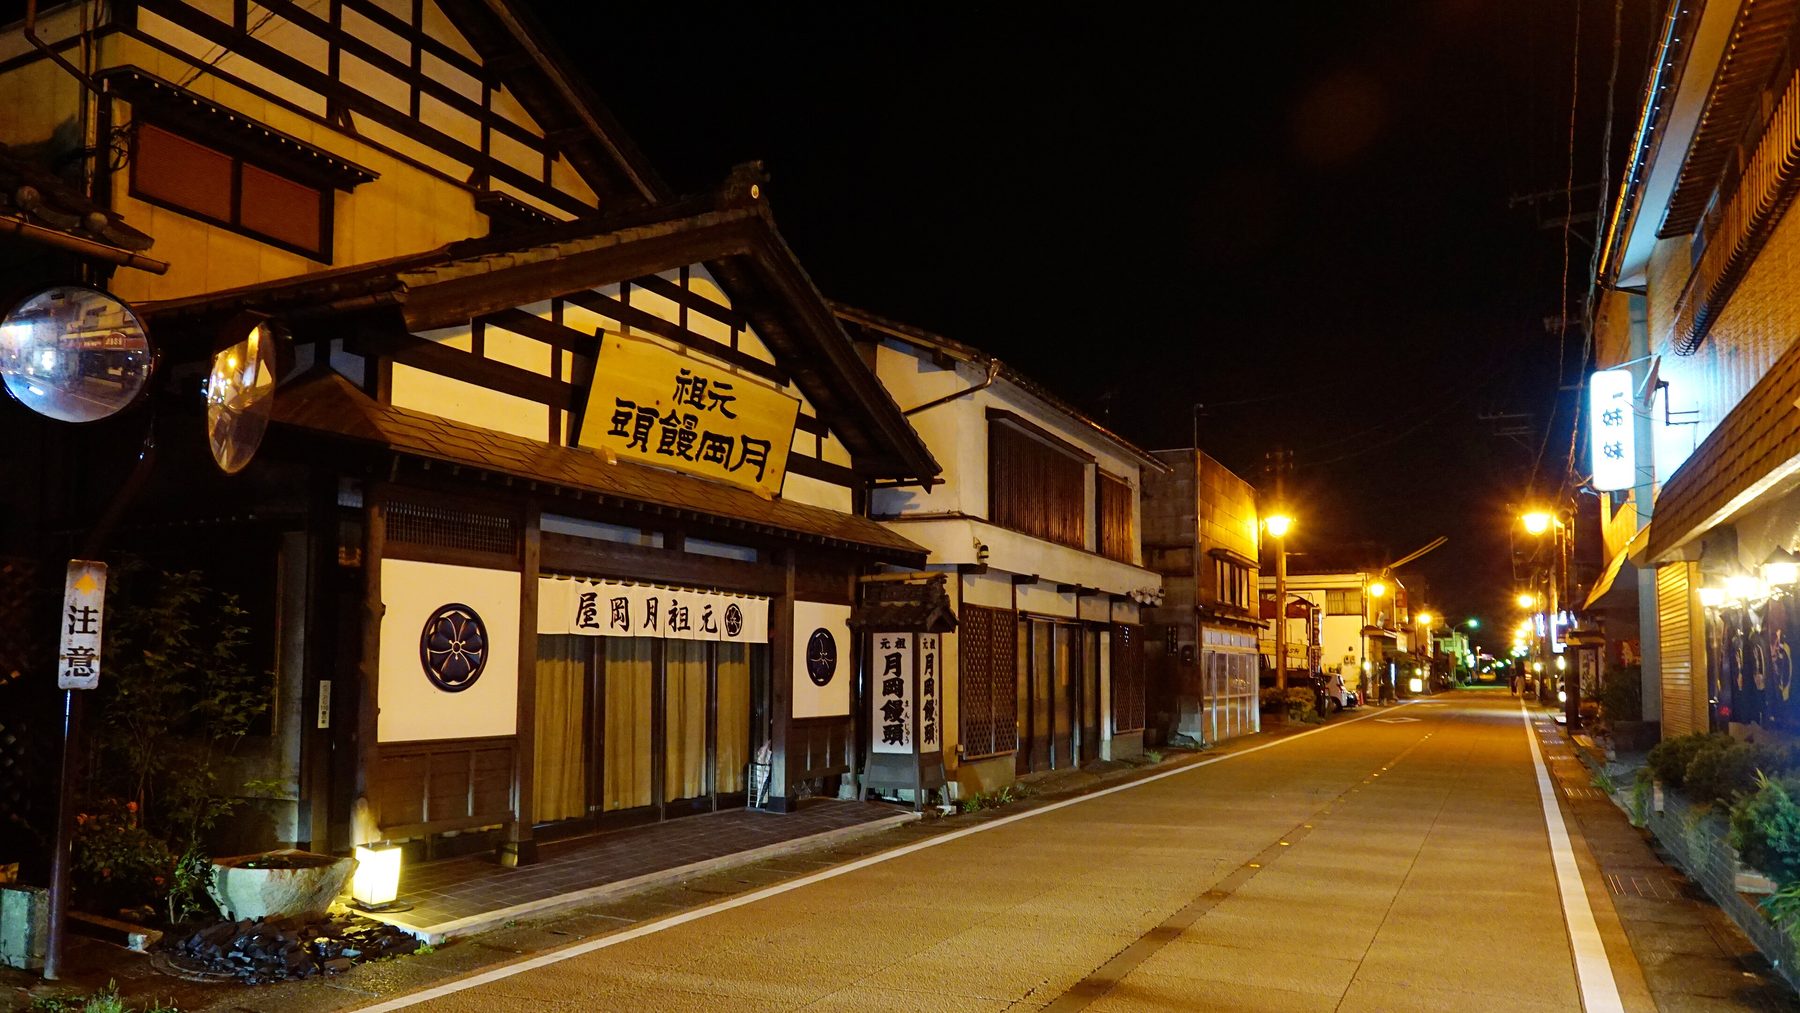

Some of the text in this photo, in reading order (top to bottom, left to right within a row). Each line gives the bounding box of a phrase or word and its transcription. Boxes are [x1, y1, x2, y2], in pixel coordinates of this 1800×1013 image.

[672, 368, 737, 419] 元祖
[65, 605, 99, 677] 注意
[880, 638, 906, 649] 元祖
